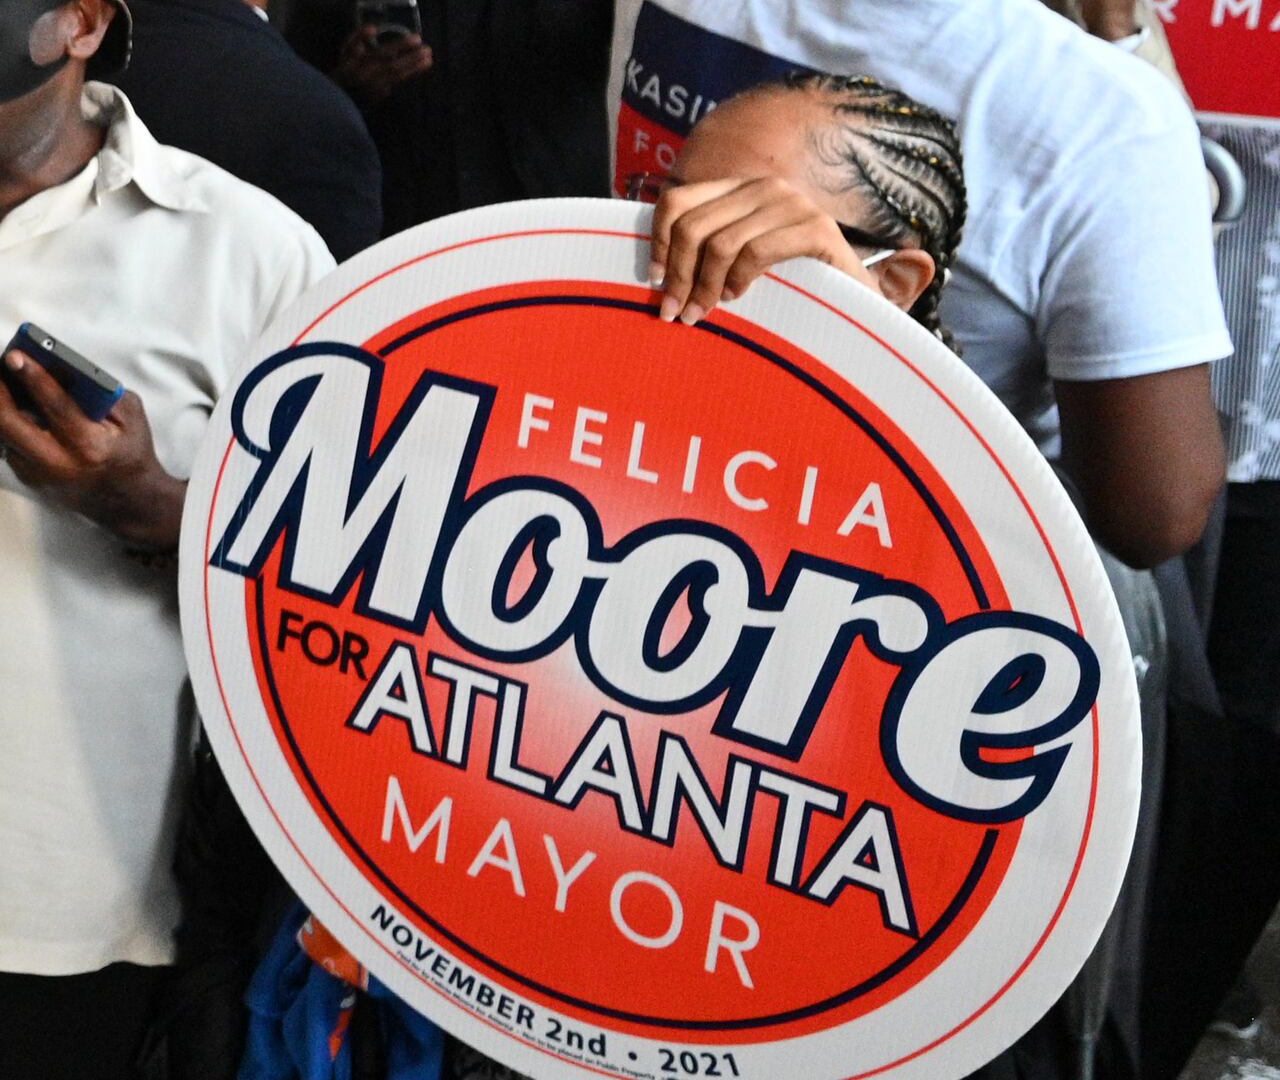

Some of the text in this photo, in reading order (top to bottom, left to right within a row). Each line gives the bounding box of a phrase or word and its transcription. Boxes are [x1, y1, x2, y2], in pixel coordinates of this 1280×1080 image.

[627, 58, 717, 124] KASI
[635, 129, 676, 170] FO
[516, 393, 893, 548] FELICIA
[208, 340, 1102, 824] Moore
[276, 608, 923, 938] FOR ATLANTA
[381, 773, 758, 989] MAYOR
[370, 905, 740, 1077] NOVEMBER 2nd 2021
